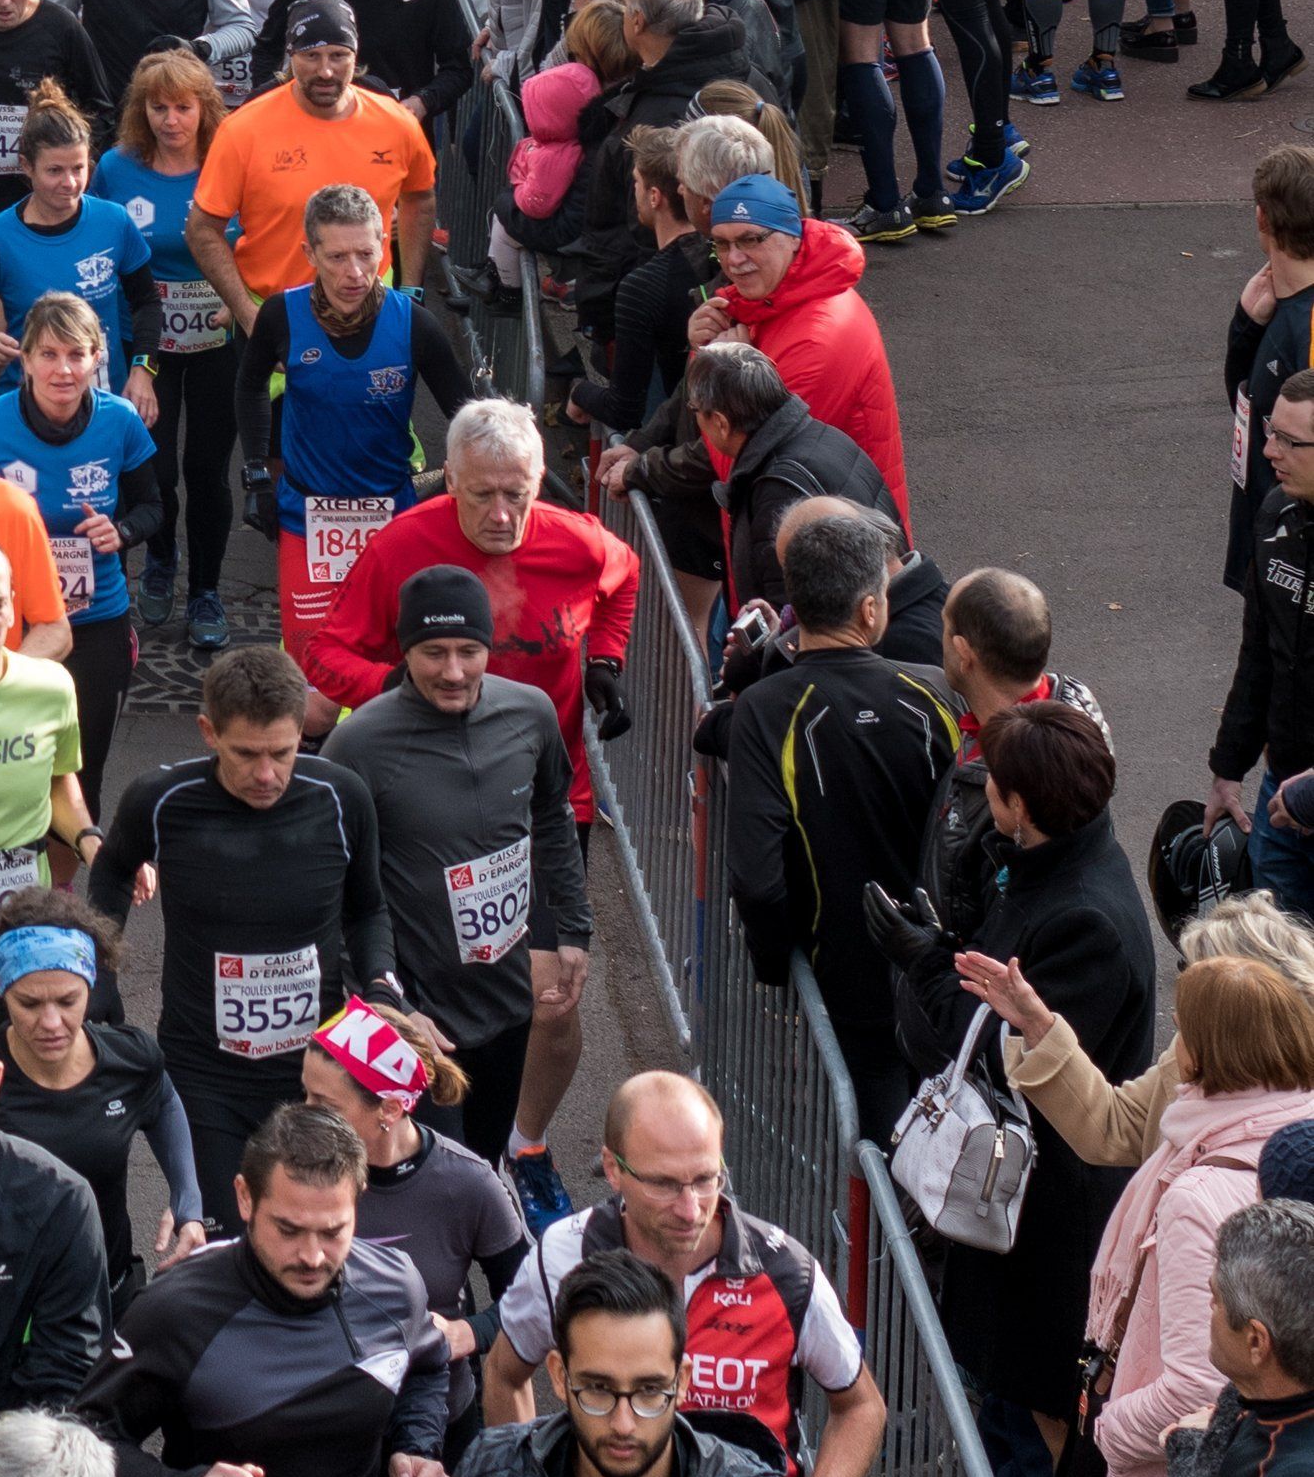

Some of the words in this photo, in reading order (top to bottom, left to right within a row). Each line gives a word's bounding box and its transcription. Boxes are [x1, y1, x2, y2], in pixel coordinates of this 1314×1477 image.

[488, 843, 520, 866] CAISSE
[457, 881, 529, 942] 3802
[263, 951, 303, 967] CAISSE
[223, 994, 315, 1034] 3552
[713, 1292, 752, 1306] KALI
